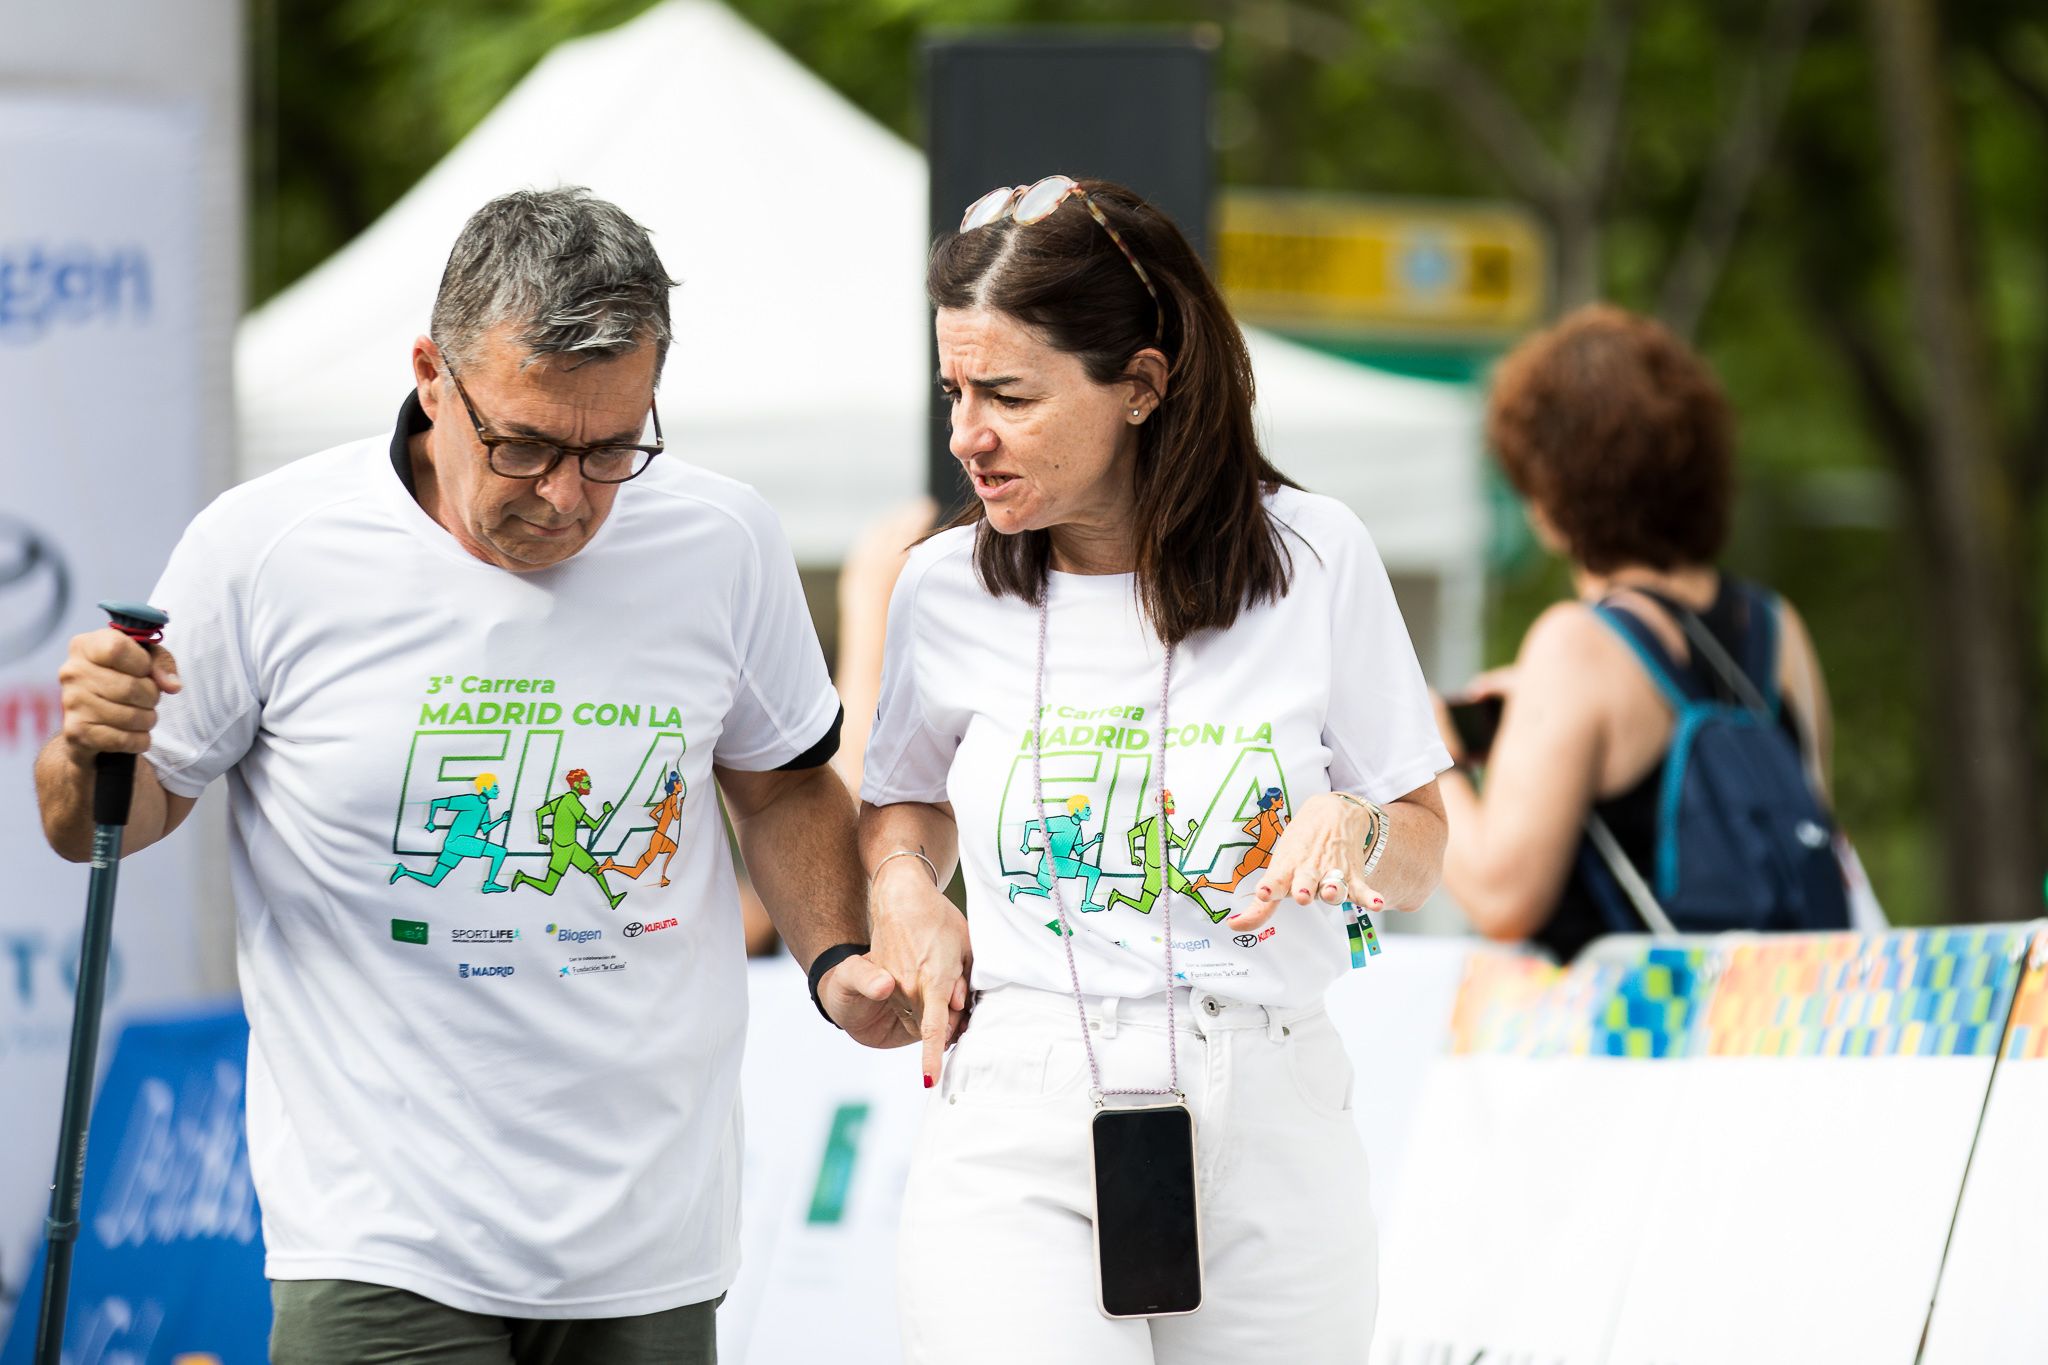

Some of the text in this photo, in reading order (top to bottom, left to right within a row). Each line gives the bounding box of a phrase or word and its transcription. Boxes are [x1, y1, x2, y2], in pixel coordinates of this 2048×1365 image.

[461, 676, 556, 694] Carrera
[419, 702, 682, 728] MADRID CON LA
[1057, 704, 1145, 721] Carrera
[1021, 722, 1273, 750] MADRID CON LA
[557, 929, 602, 943] Biogen
[472, 966, 515, 977] MADRID
